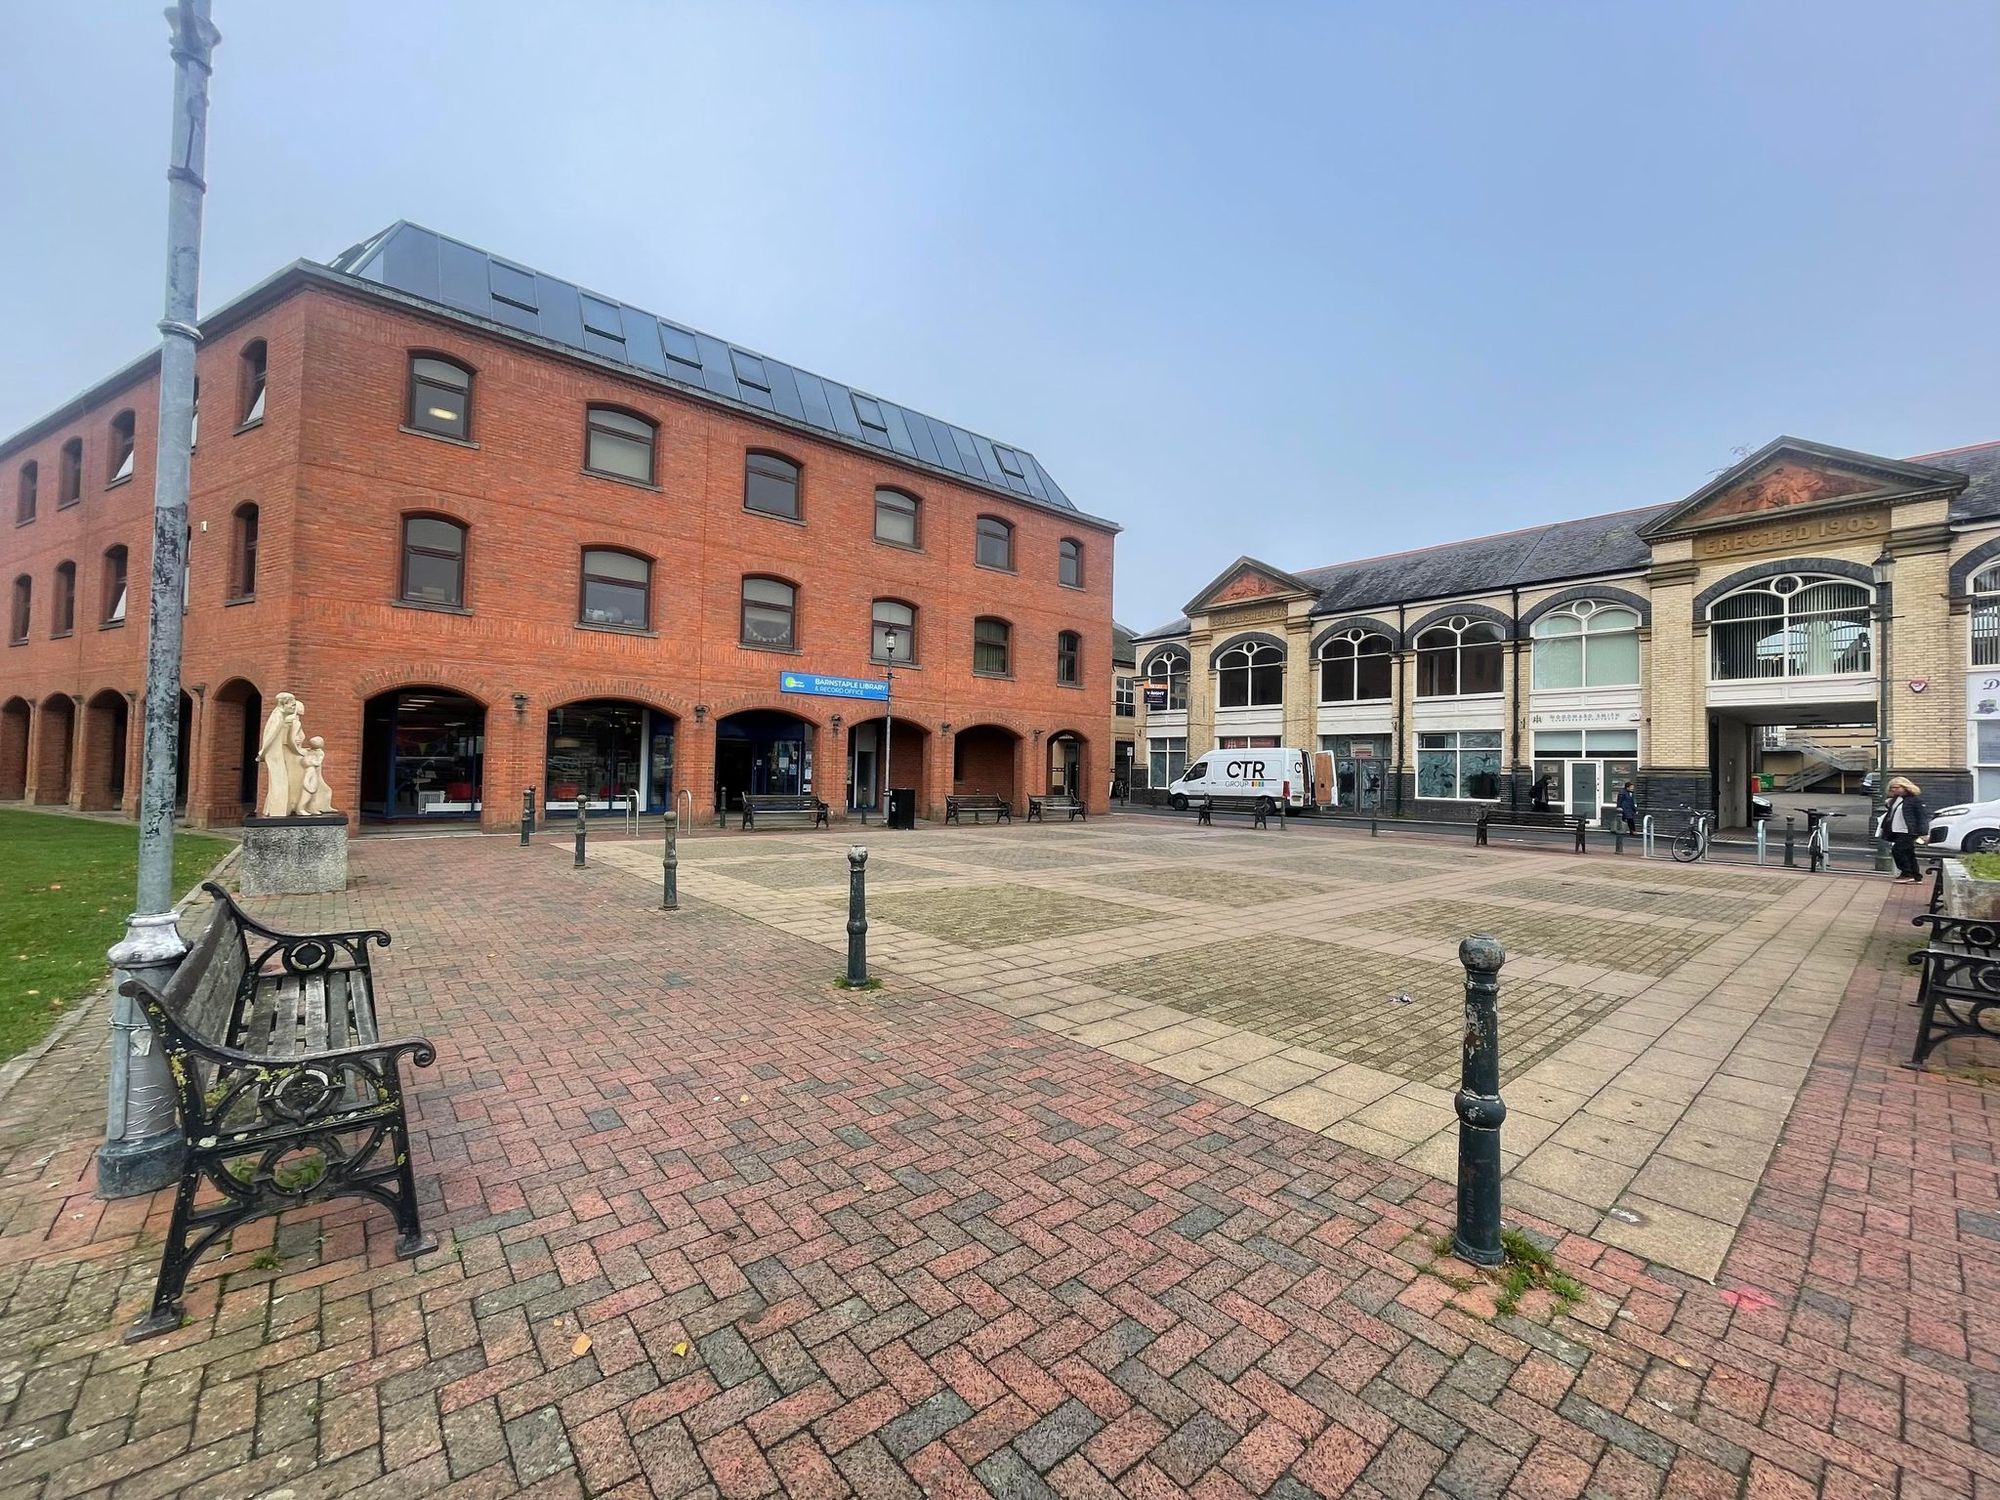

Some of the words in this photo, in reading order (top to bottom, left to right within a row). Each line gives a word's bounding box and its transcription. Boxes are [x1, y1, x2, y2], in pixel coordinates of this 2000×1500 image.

[1704, 524, 1811, 554] ERECTED
[1819, 515, 1880, 538] 1903
[815, 678, 859, 689] BARNSTAPLE
[859, 682, 886, 691] LIBRARY
[1226, 760, 1266, 779] CTR
